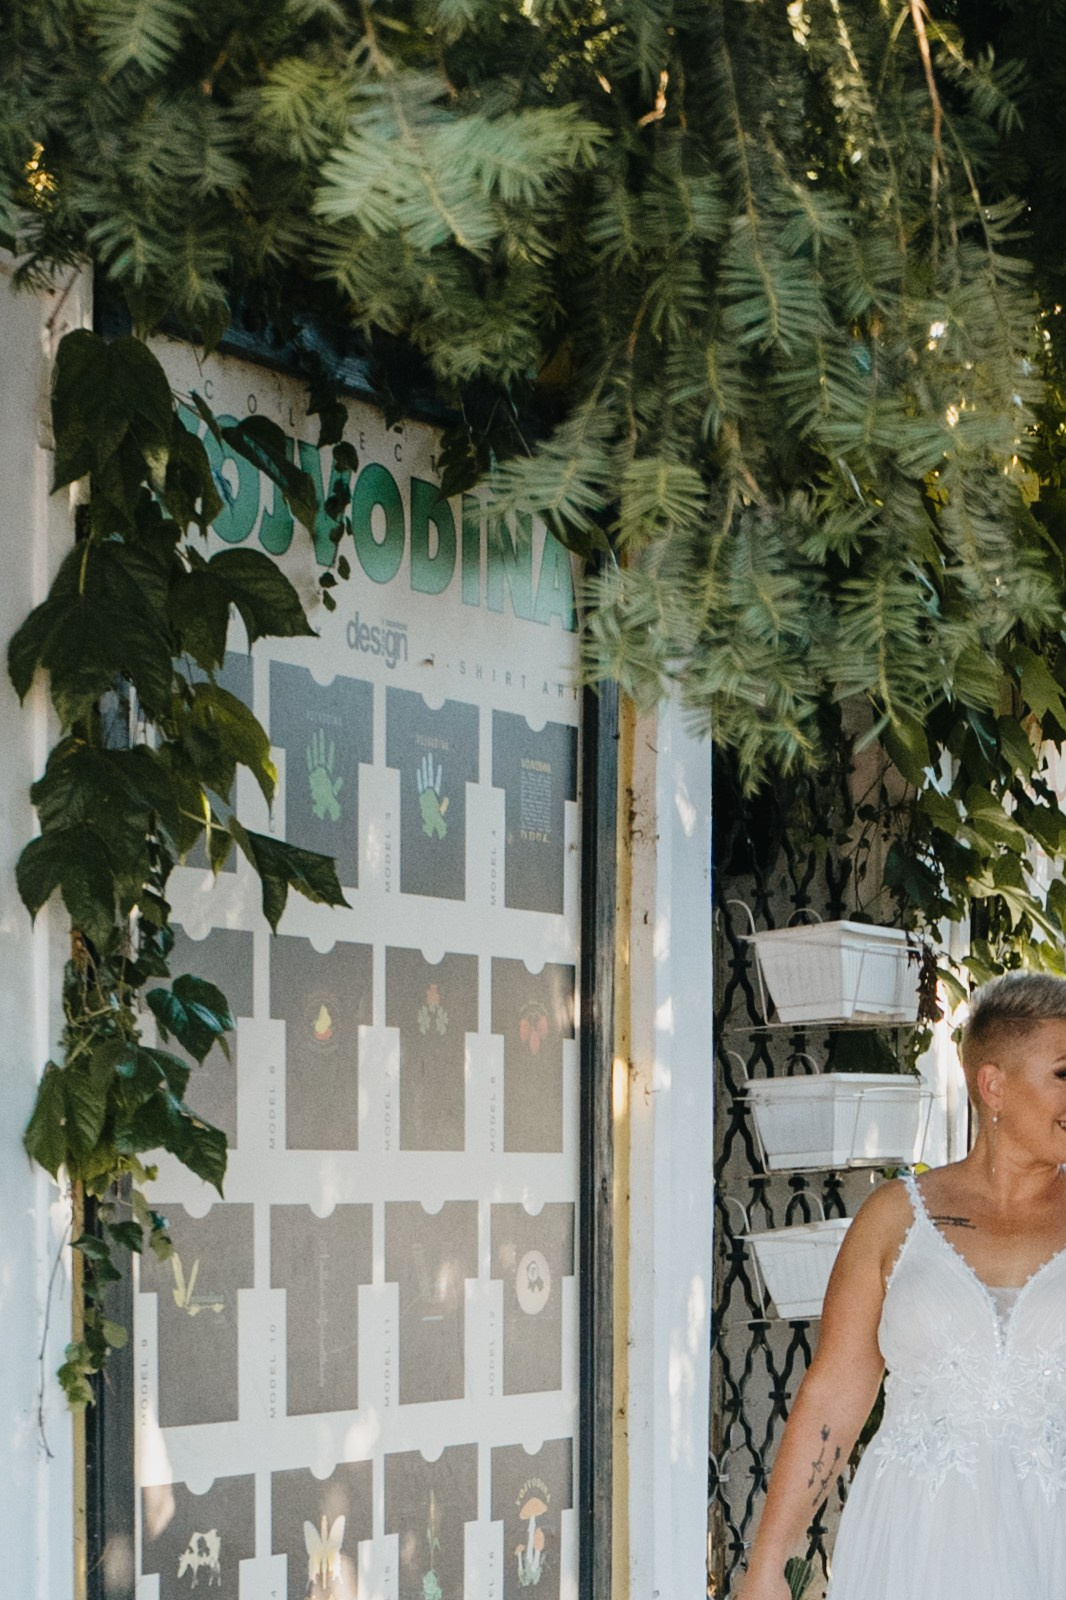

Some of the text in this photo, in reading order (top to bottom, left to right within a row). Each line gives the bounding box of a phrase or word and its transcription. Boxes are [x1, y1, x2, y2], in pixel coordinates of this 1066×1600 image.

[155, 403, 579, 632] OJVODINA
[384, 830, 392, 894] MODEL
[489, 847, 498, 907] MODEL
[267, 1085, 277, 1150] MODEL
[383, 1089, 392, 1152] MODEL
[488, 1093, 497, 1153] MODEL
[268, 1353, 277, 1420] MODEL
[383, 1345, 392, 1408] MODEL
[488, 1337, 496, 1397] MODEL
